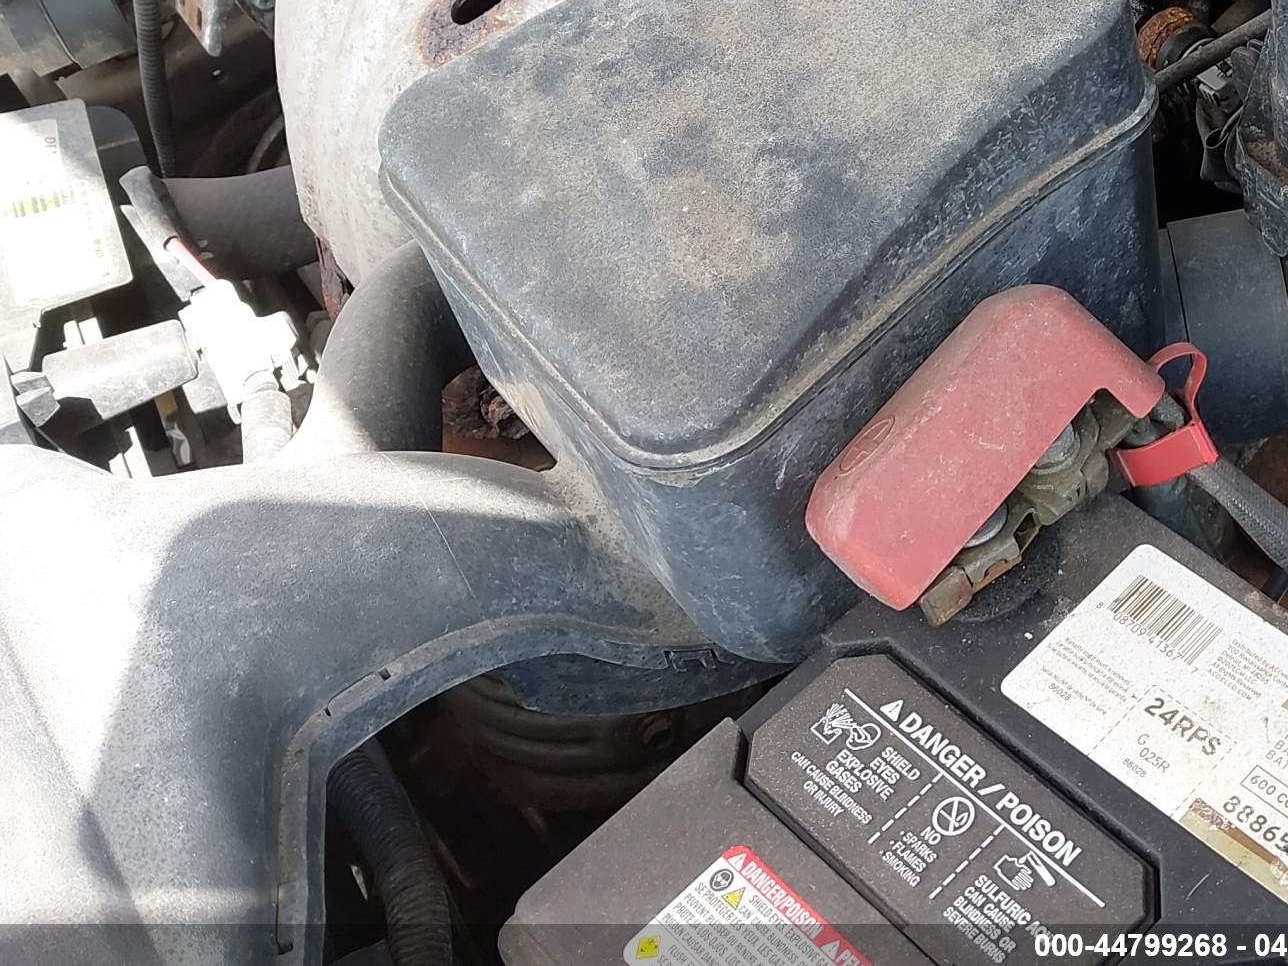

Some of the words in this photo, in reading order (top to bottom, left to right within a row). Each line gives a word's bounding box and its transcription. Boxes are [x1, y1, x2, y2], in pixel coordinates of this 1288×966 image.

[1143, 696, 1223, 758] 24RPS
[822, 759, 864, 794] GASES
[835, 748, 895, 801] EXPLOSIVE
[867, 756, 902, 786] EYES
[879, 744, 923, 782] SHIELD
[1137, 745, 1172, 774] 025R
[788, 750, 813, 771] CAN
[803, 763, 835, 791] CAUSE
[826, 784, 875, 826] BLINDNESS
[801, 779, 820, 795] OR
[811, 789, 845, 818] INJURY
[897, 710, 989, 789] DANGER
[992, 790, 1084, 867] POISON
[1248, 772, 1278, 796] 600
[889, 840, 929, 874] FLAMES
[899, 830, 939, 864] SPARKS
[918, 824, 944, 847] NO
[881, 850, 921, 888] SMOKING
[739, 859, 825, 941] DANGER/POISON
[961, 885, 987, 907] CAN
[980, 902, 1017, 933] CAUSE
[972, 873, 1033, 927] SULFURIC
[747, 893, 772, 918] SHIELD
[783, 928, 819, 963] EXPLOSIVE
[940, 904, 981, 939] SEVERE
[971, 932, 1009, 964] BURNS
[949, 894, 1004, 941] BLINDNESS
[996, 934, 1019, 954] OR
